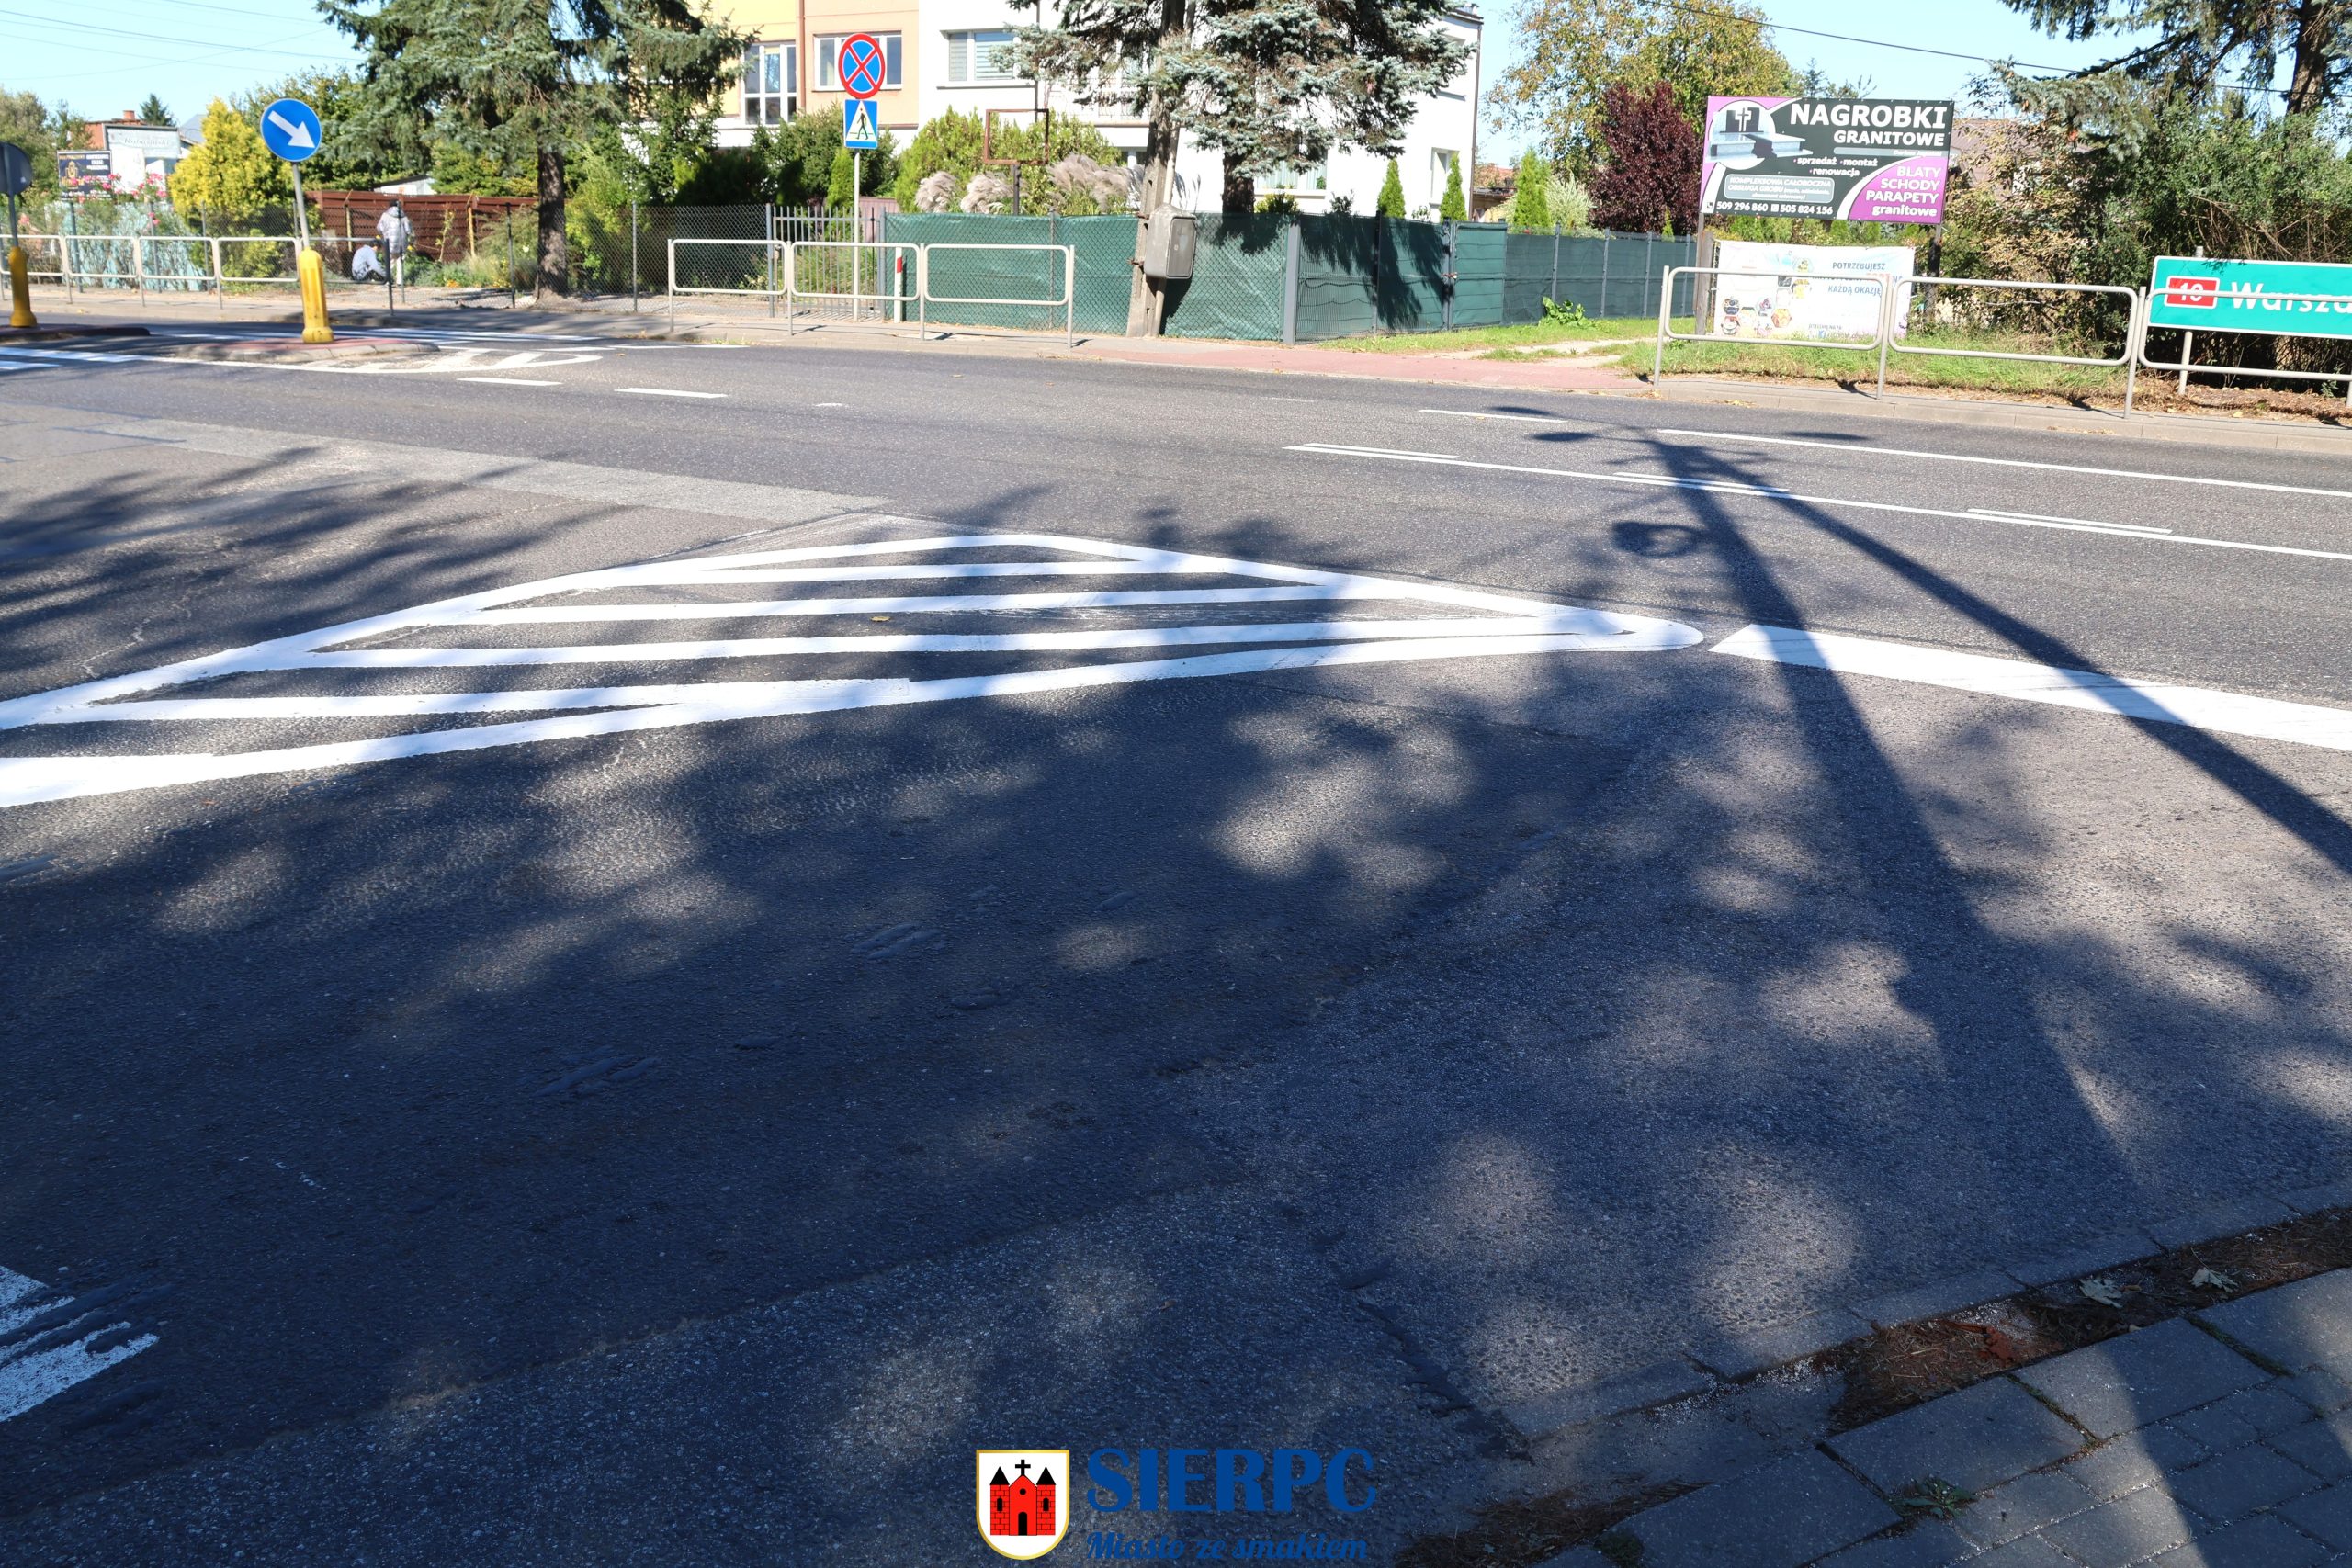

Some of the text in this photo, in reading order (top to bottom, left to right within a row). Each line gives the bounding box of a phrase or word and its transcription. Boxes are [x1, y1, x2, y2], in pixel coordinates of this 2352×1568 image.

[1791, 103, 1948, 129] NAGROBKI
[1834, 130, 1945, 147] GRANITOWE
[1796, 156, 1878, 167] sprzedaż montaż
[1813, 168, 1860, 177] renowacja
[1897, 165, 1941, 178] BLATY
[1881, 178, 1941, 191] SCHODY
[1866, 190, 1939, 204] PARAPETY
[1716, 201, 1833, 215] 509 296 860 505 824 156
[1872, 203, 1938, 217] granitowe
[1832, 262, 1886, 272] POTRZEBUJESZ
